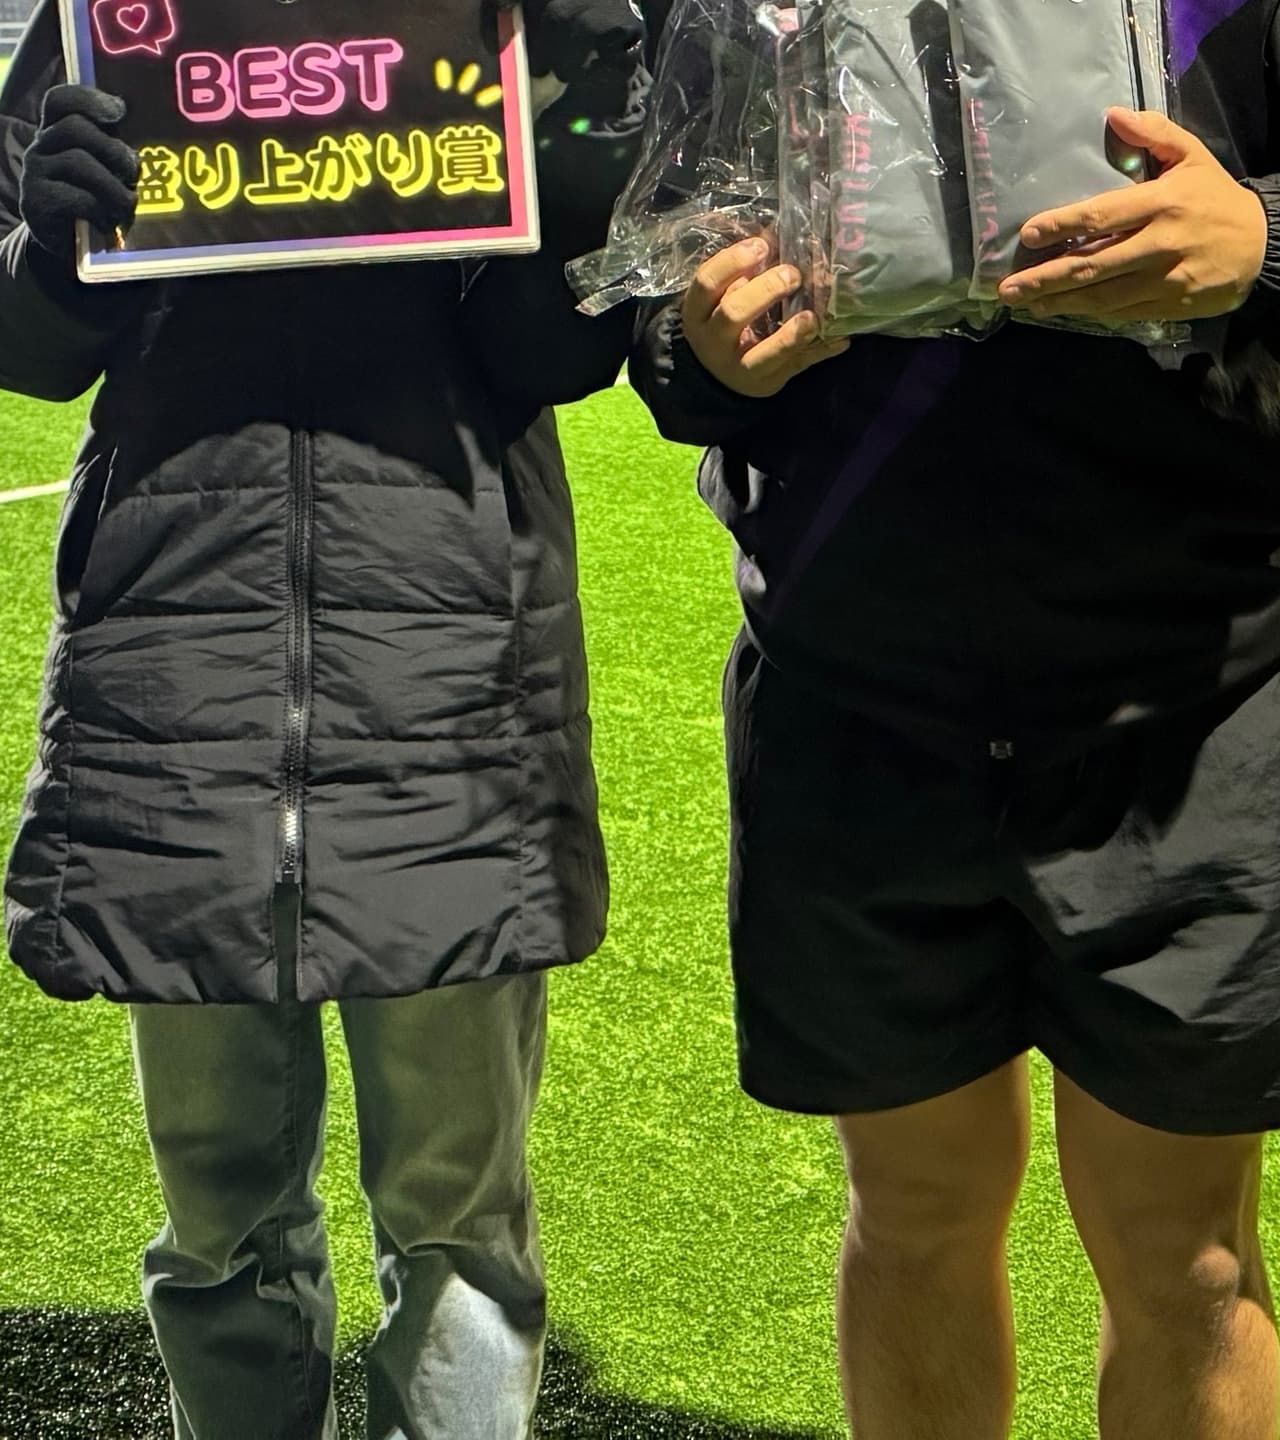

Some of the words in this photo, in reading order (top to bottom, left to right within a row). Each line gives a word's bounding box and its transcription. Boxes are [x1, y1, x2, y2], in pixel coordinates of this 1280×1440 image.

[176, 38, 404, 122] BEST
[135, 124, 505, 215] 盛り上がり賞
